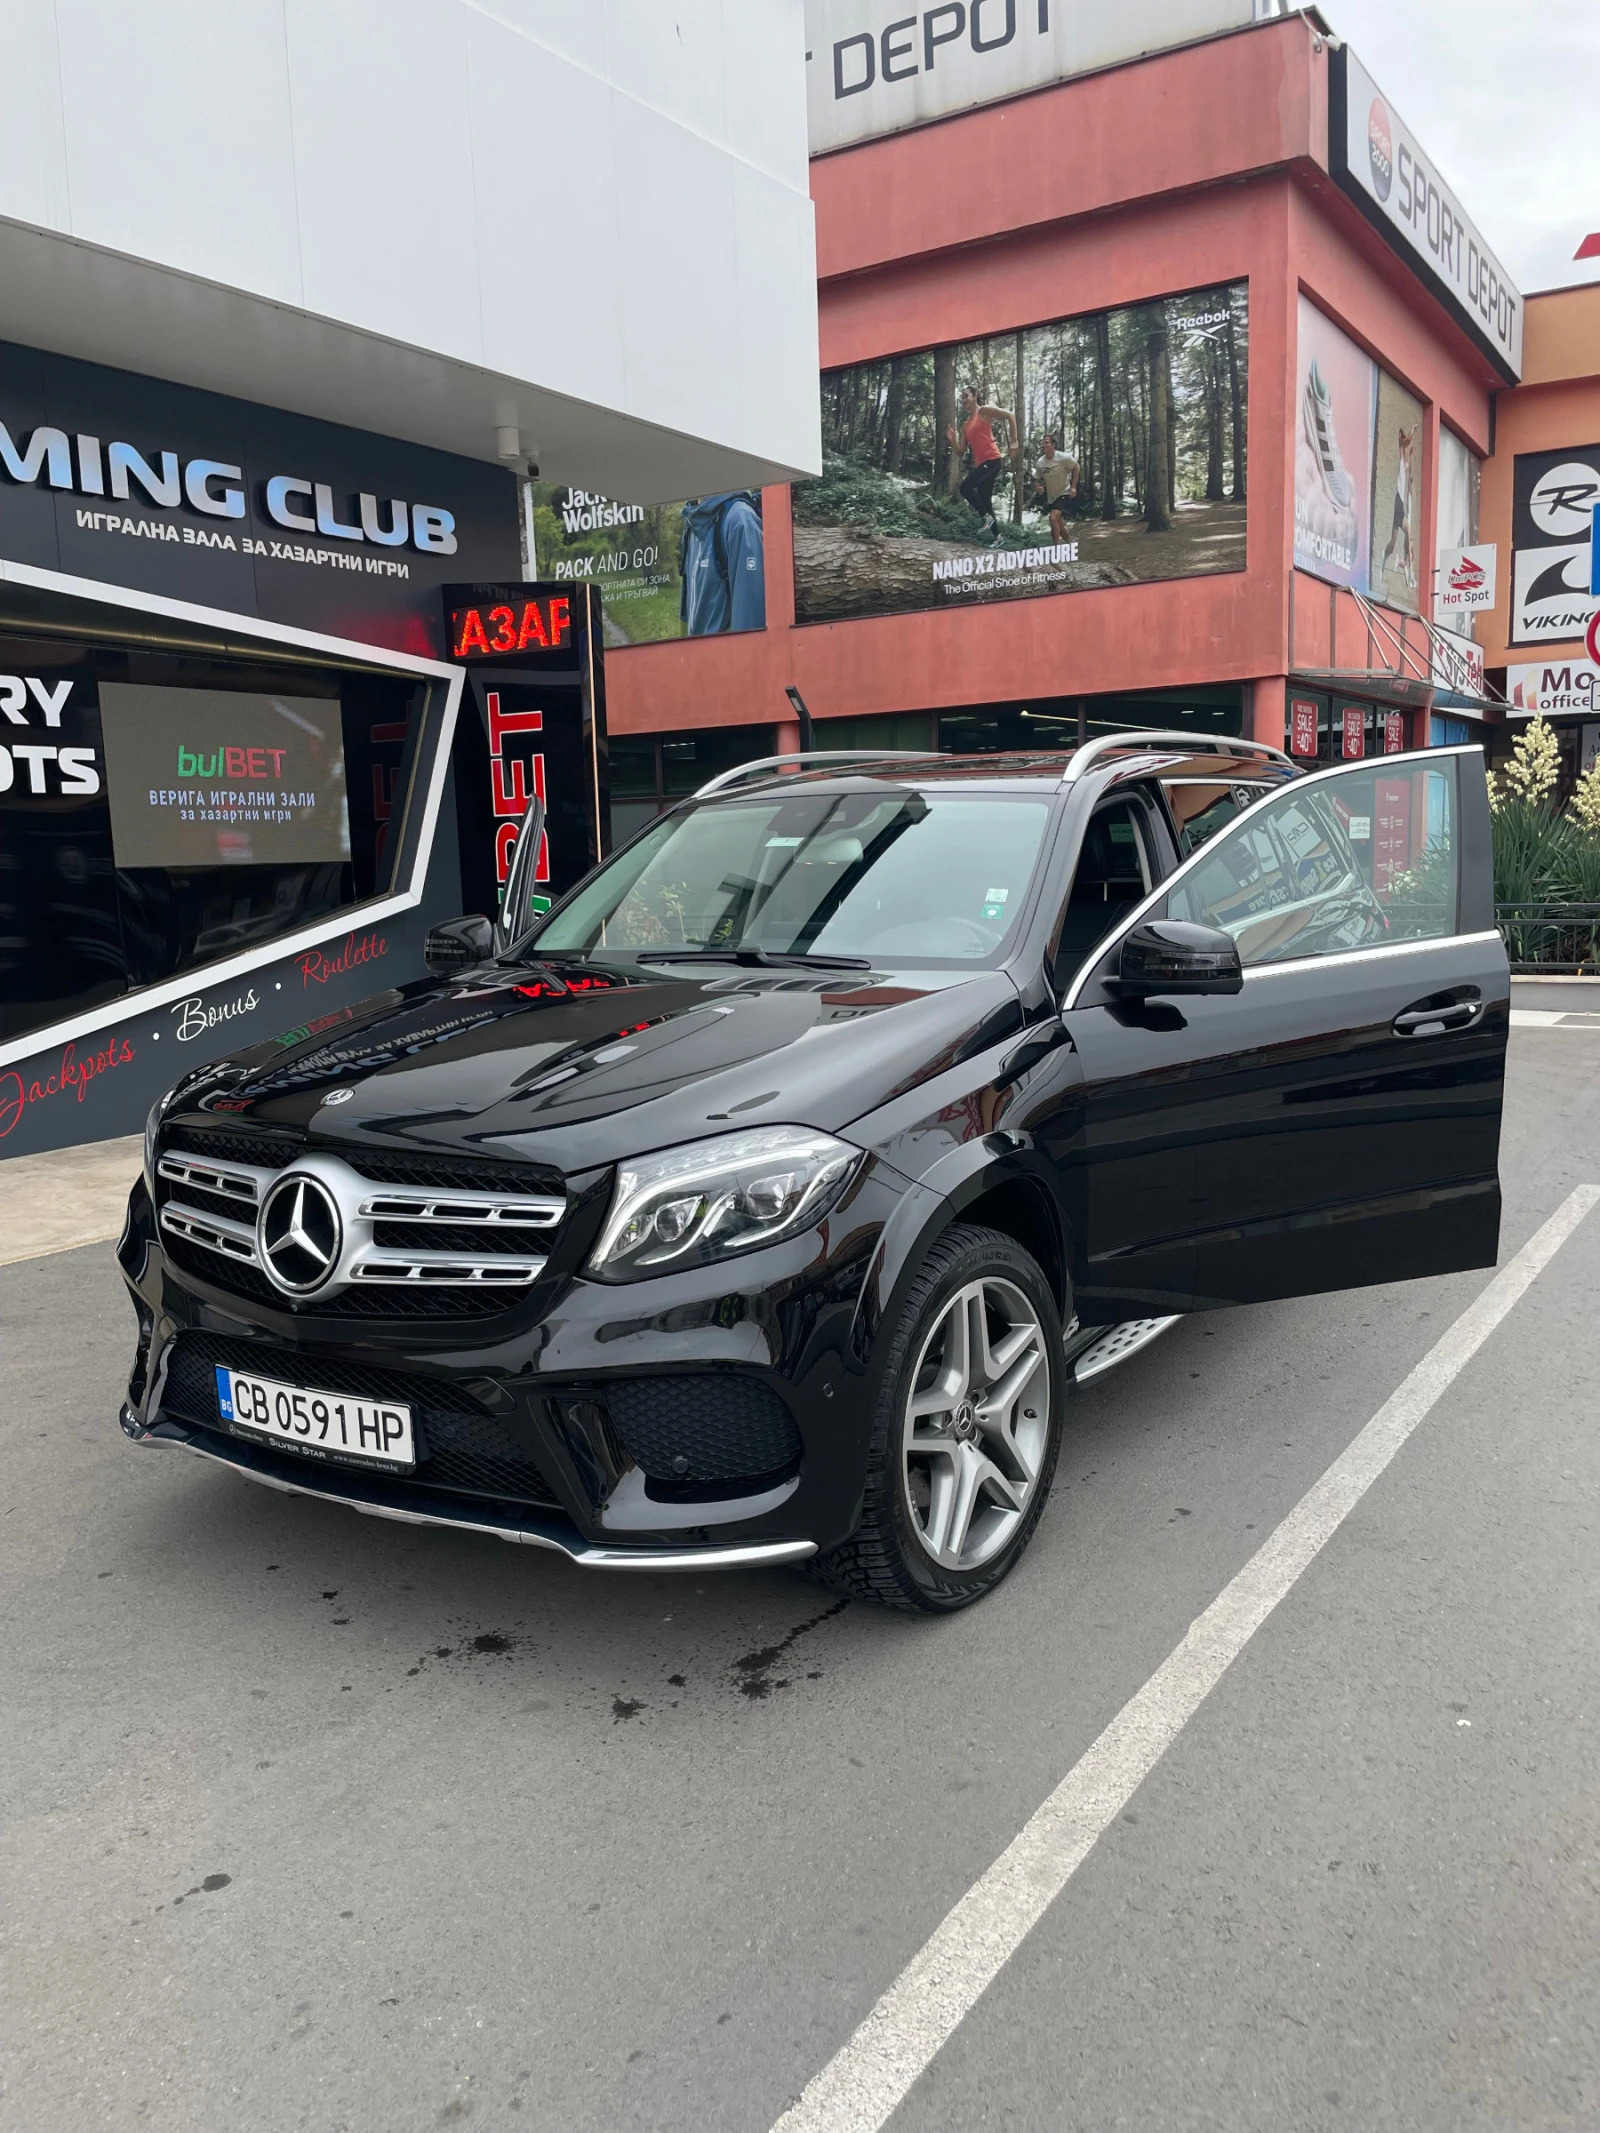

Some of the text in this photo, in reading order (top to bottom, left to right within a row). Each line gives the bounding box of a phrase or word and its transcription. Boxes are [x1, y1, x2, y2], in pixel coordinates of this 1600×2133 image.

[1371, 143, 1389, 178] 2000
[1399, 142, 1516, 352] SPORT DEPOT
[1176, 309, 1230, 330] Reebok
[266, 475, 458, 555] CLUB
[562, 501, 644, 533] Wolfskin
[76, 508, 409, 579] ИГРАЛНА ЗАЛА ЗА ХАЗАРТНИ ИГРИ
[555, 546, 658, 580] PACK AND GO!
[933, 542, 1078, 580] NANO X2 ADVENTURE
[617, 592, 623, 600] И
[624, 585, 659, 600] ТРЪГВАЙ
[637, 576, 648, 587] СИ
[944, 570, 1066, 595] The Official Shoe of Fitness
[1443, 590, 1489, 604] Hot Spot
[452, 597, 571, 657] АЗАР
[0, 675, 74, 727] RY
[1540, 695, 1590, 709] office
[1297, 713, 1312, 732] SALE
[1348, 720, 1360, 737] SALE
[1388, 727, 1399, 742] SALE
[178, 745, 287, 778] bulBET
[150, 790, 315, 806] ВЕРИГА ИГРАЛНИ ЗАЛИ
[180, 810, 291, 823] за хазартни игри
[294, 932, 390, 989] Roulette
[170, 988, 260, 1042] Bonus
[0, 1038, 135, 1137] Jackpots
[221, 1399, 232, 1412] BG
[234, 1380, 404, 1451] CB 0591 HP
[269, 1437, 299, 1452] SILVER
[302, 1446, 326, 1459] STAR
